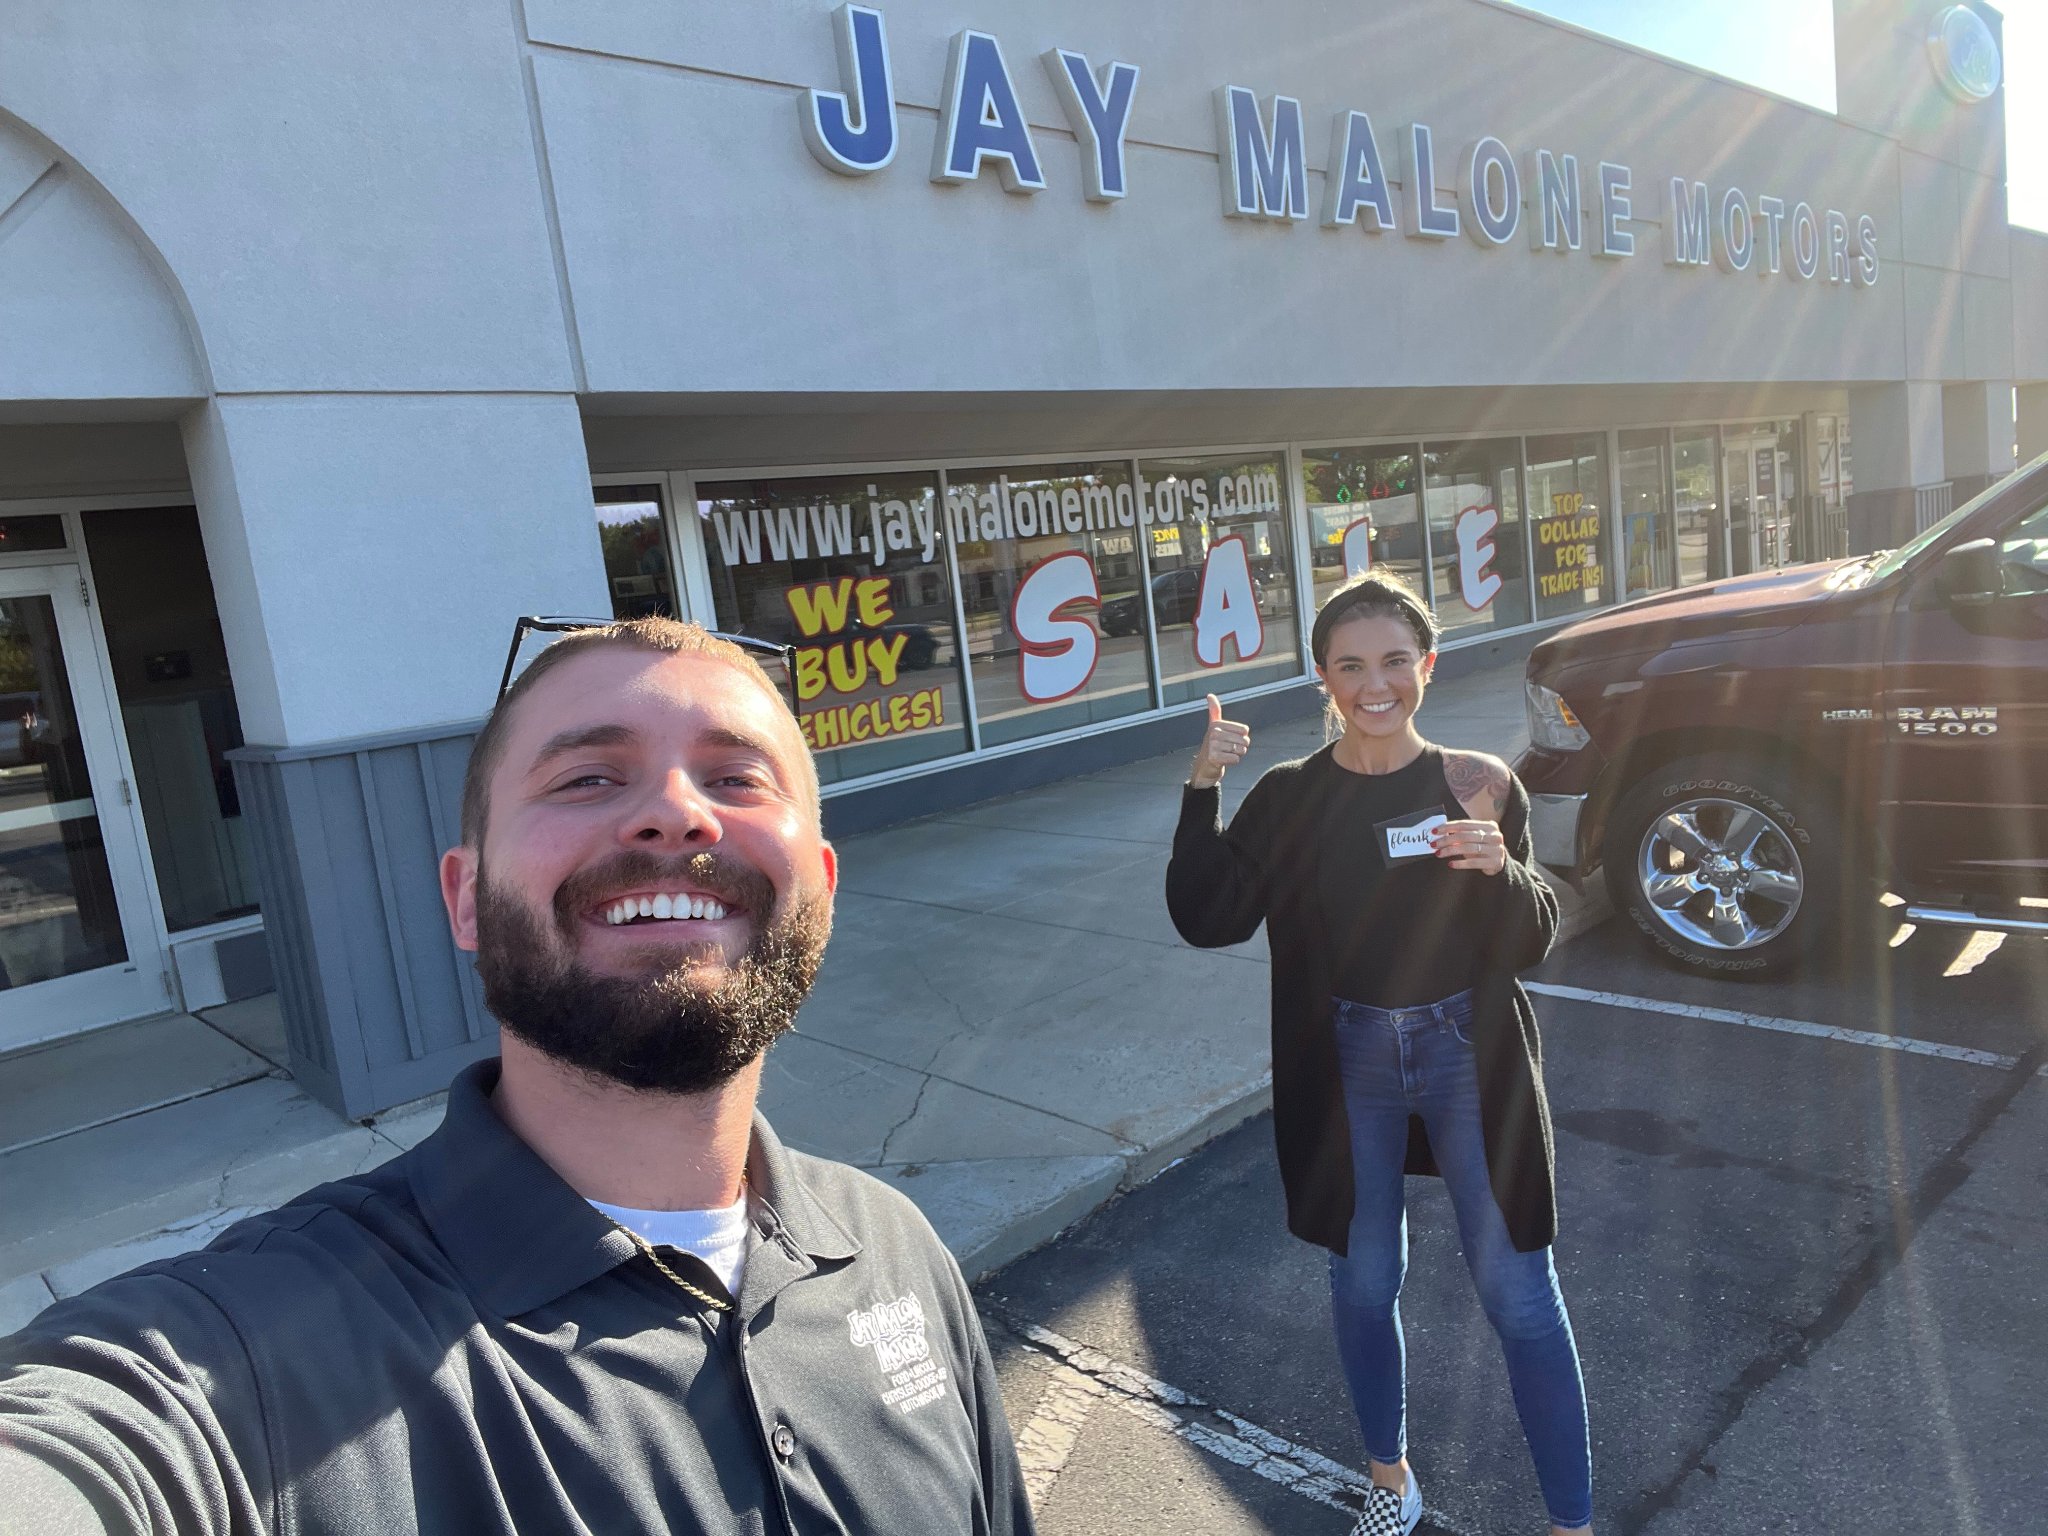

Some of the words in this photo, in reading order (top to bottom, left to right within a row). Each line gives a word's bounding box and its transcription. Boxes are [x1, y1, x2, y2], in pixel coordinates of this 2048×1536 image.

[798, 2, 1140, 202] JAY
[1214, 84, 1635, 258] MALONE
[1666, 176, 1880, 287] MOTORS
[713, 473, 1280, 566] www.jaymalonemotors.com
[1552, 492, 1584, 516] TOP
[1540, 516, 1600, 545] DOLLAR
[1555, 543, 1588, 568] FOR
[1540, 565, 1604, 597] TRADE-INS!
[785, 576, 895, 639] WE
[787, 632, 909, 702] BUY
[799, 686, 945, 748] EHICLES!
[1822, 709, 1873, 721] HEMI
[1897, 706, 1998, 721] RAM
[1897, 722, 1998, 735] 1500
[1663, 779, 1811, 843] GOODYEAR
[847, 1309, 880, 1347] JAY
[874, 1328, 929, 1373] MOTORS
